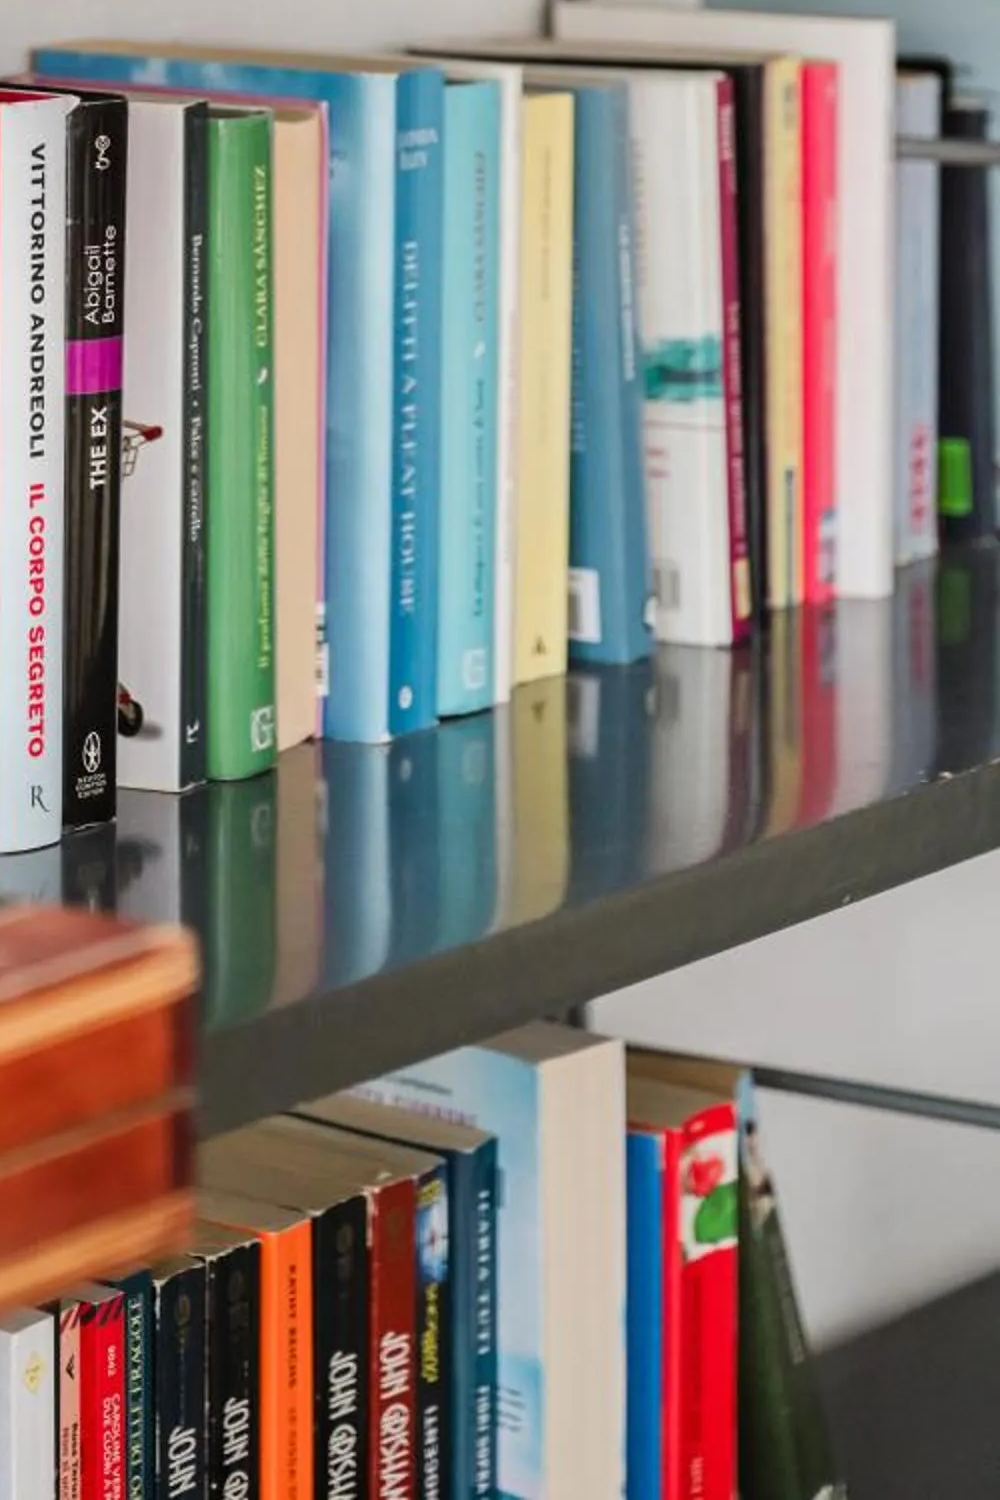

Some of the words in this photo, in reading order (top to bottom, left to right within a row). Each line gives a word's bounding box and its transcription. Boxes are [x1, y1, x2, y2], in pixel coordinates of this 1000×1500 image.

[29, 143, 47, 305] VITTORINO
[83, 244, 104, 325] Abigail
[101, 224, 117, 324] Barnette
[255, 274, 268, 347] CLARA
[29, 313, 46, 458] ANDREOLI
[90, 405, 107, 438] EX
[28, 482, 45, 508] IL
[89, 445, 107, 490] THE
[28, 515, 46, 617] CORPO
[26, 624, 46, 758] SEGRETO
[328, 1350, 358, 1420] JOHN
[379, 1331, 412, 1400] JOHN
[168, 1425, 197, 1498] JOHN
[223, 1396, 249, 1466] JOHN
